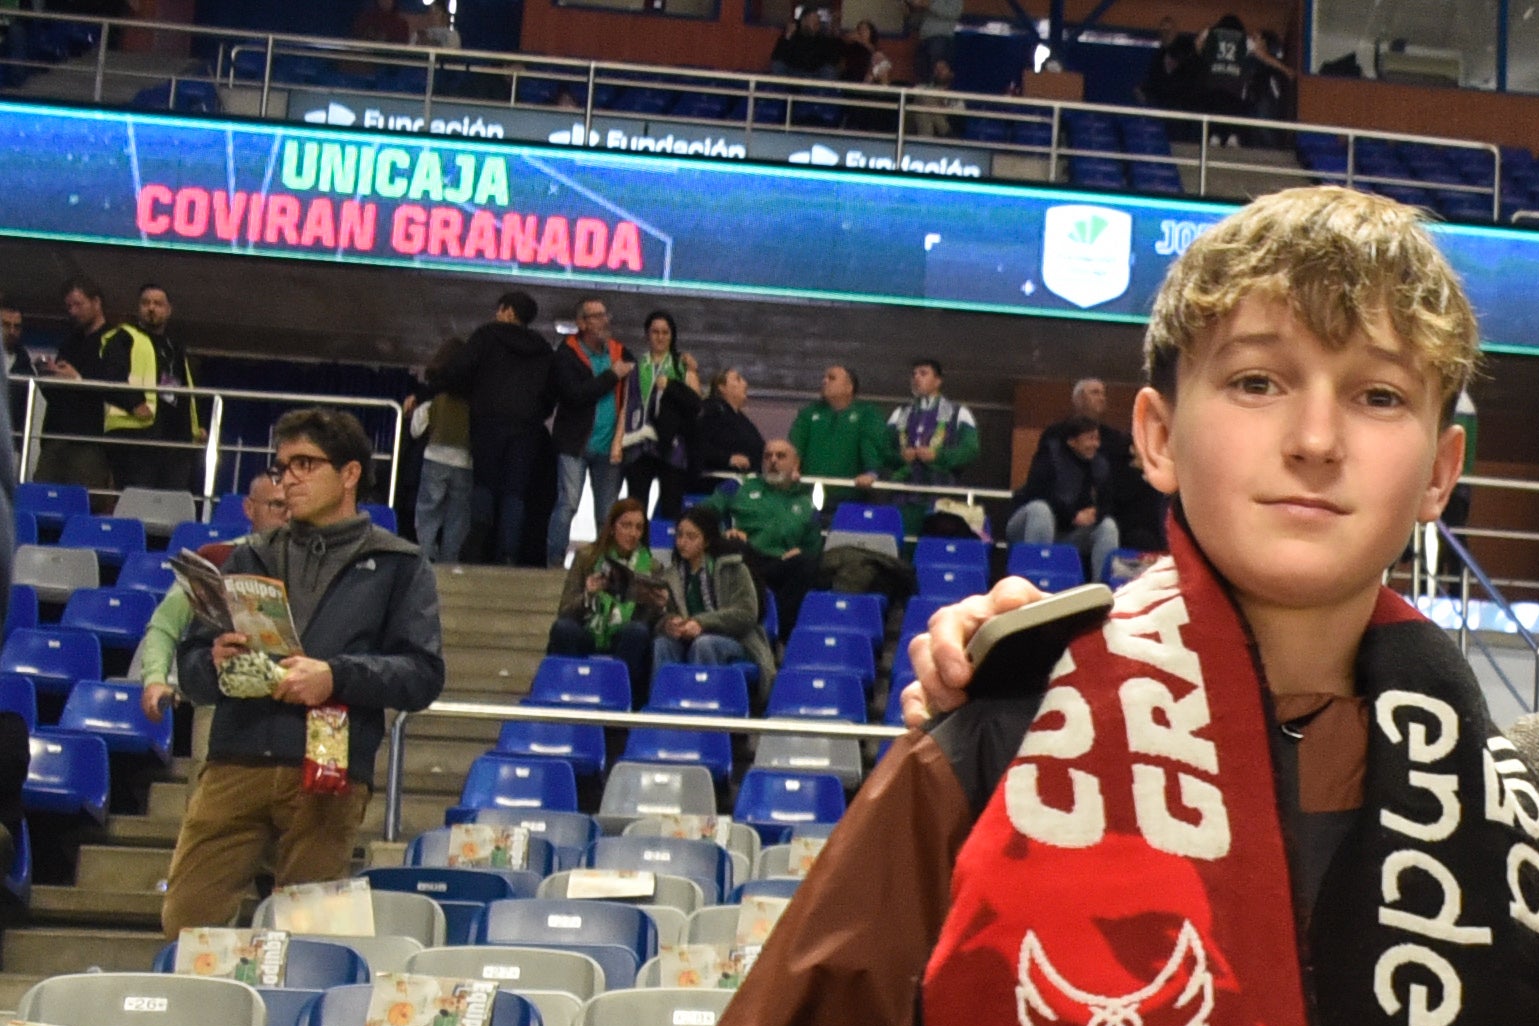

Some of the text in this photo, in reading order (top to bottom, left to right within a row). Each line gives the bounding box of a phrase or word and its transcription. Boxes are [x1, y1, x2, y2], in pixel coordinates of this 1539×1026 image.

[282, 140, 509, 206] UNICAJA
[136, 185, 643, 271] COVIRAN GRANADA
